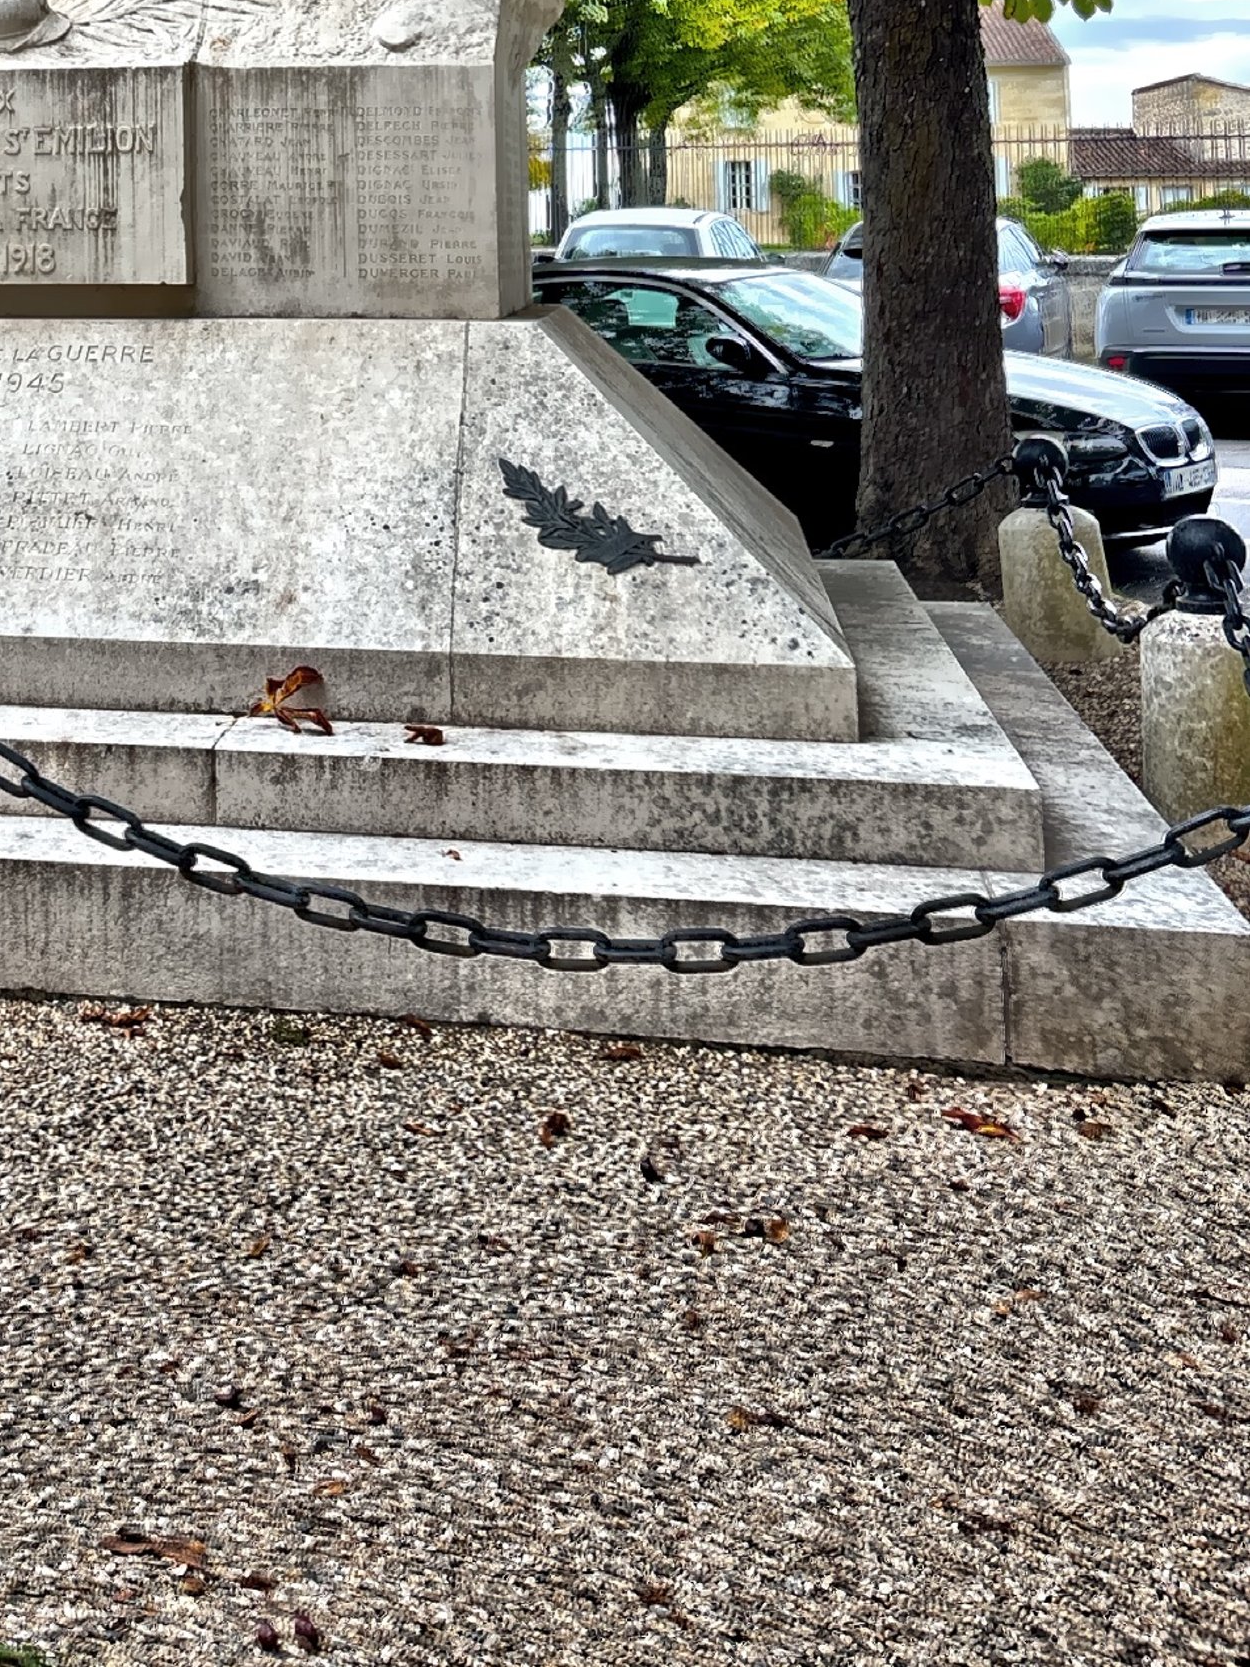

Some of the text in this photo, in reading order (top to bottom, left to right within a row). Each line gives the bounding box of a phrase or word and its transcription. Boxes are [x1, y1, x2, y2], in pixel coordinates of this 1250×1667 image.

[34, 122, 155, 156] EMILION
[16, 208, 118, 232] FRANCE
[4, 242, 57, 274] 1918
[358, 252, 483, 265] DUSSERET LOUIS
[12, 347, 41, 362] LA
[47, 345, 155, 363] GUERRE
